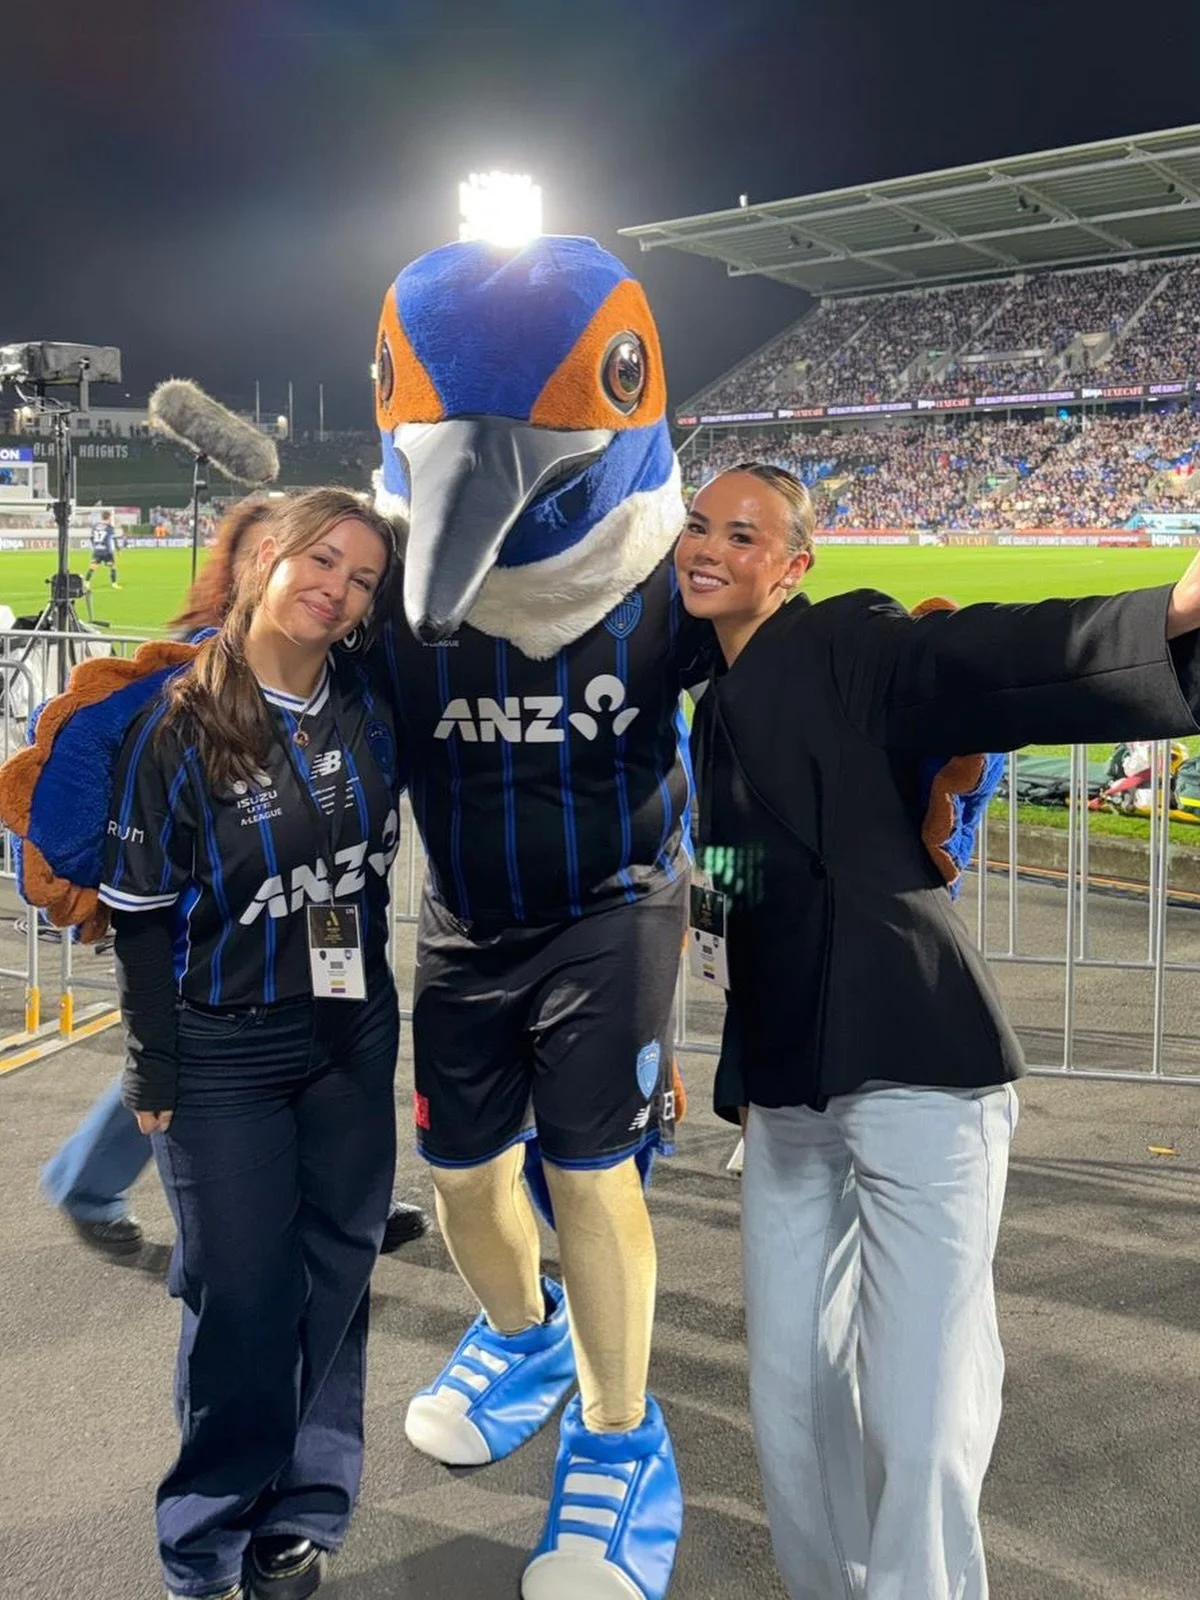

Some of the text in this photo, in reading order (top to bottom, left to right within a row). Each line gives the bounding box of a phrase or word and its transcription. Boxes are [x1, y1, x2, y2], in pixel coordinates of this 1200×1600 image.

[79, 443, 129, 459] KNIGHTS
[433, 696, 565, 742] ANZ
[237, 790, 278, 809] ISUZU
[240, 807, 283, 827] A-LEAGUE
[239, 840, 369, 925] ANZ
